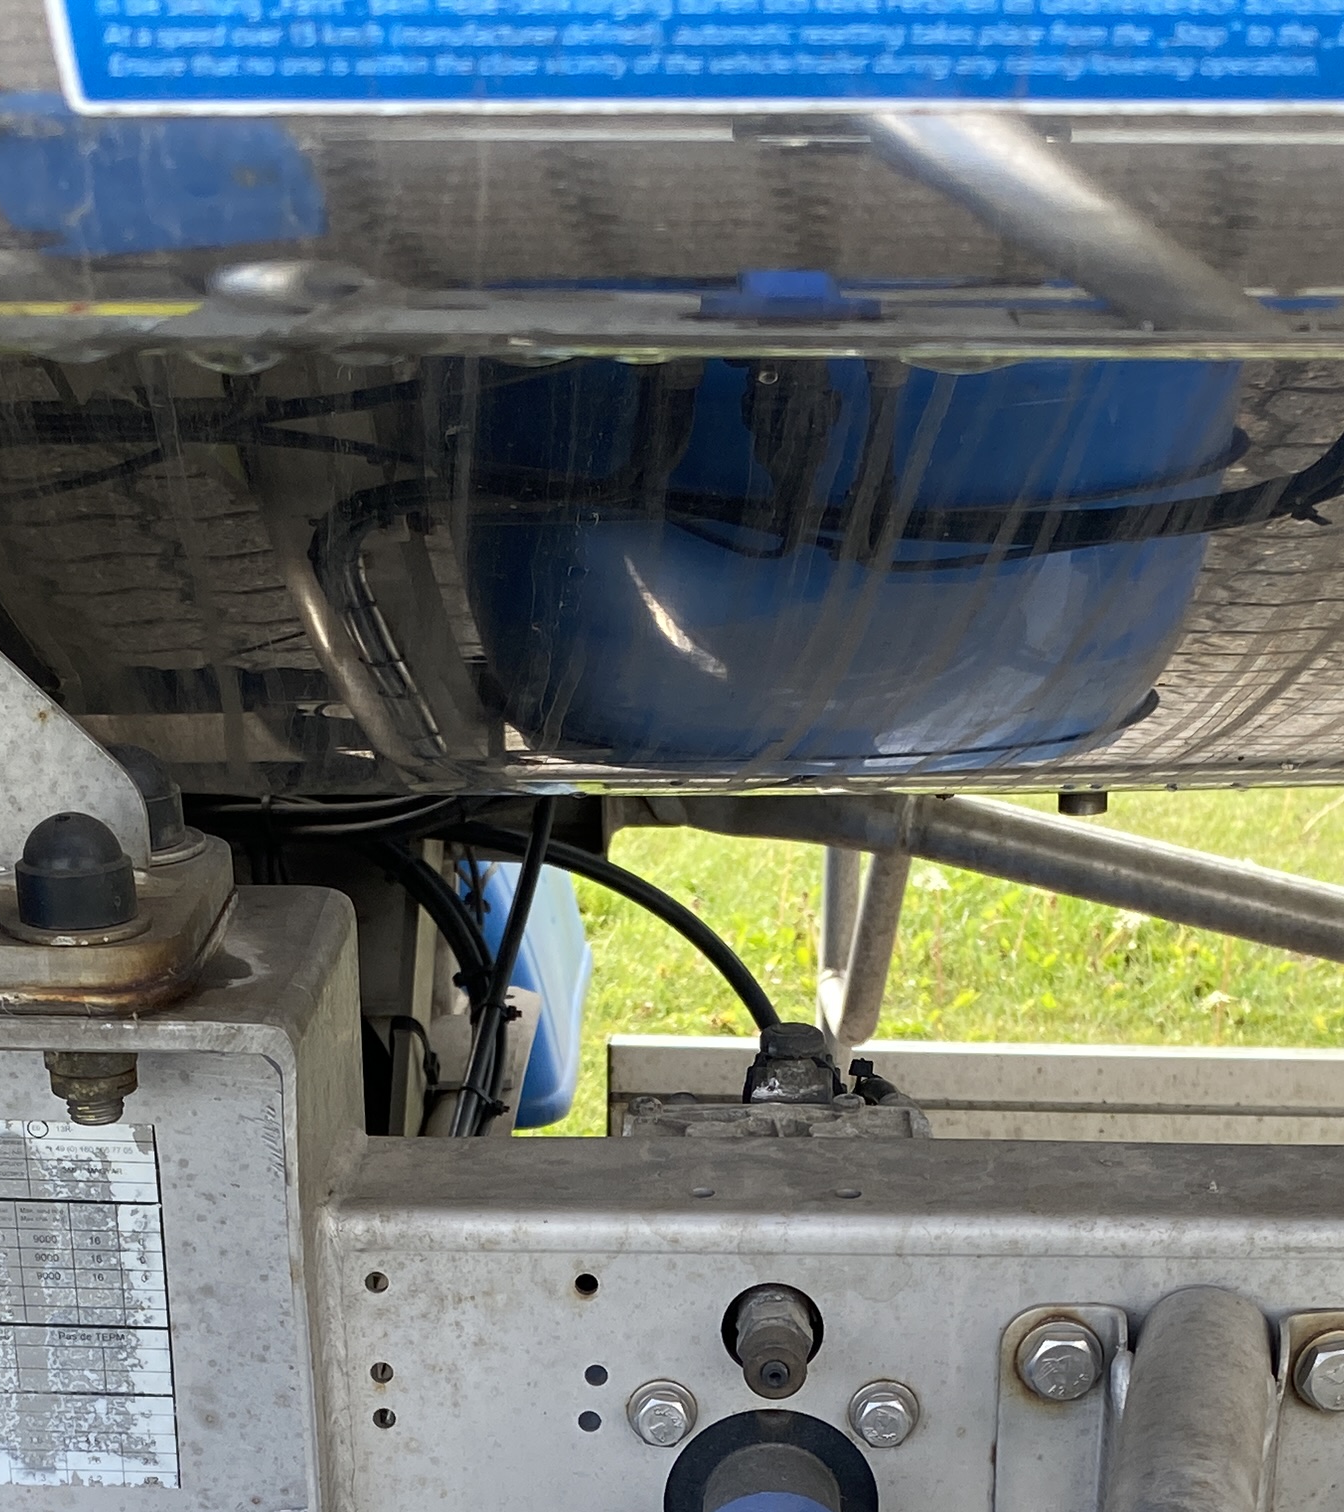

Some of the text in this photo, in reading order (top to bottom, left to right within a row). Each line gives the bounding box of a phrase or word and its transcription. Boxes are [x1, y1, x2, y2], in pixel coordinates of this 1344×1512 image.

[58, 1331, 126, 1342] Pas de TEPM
